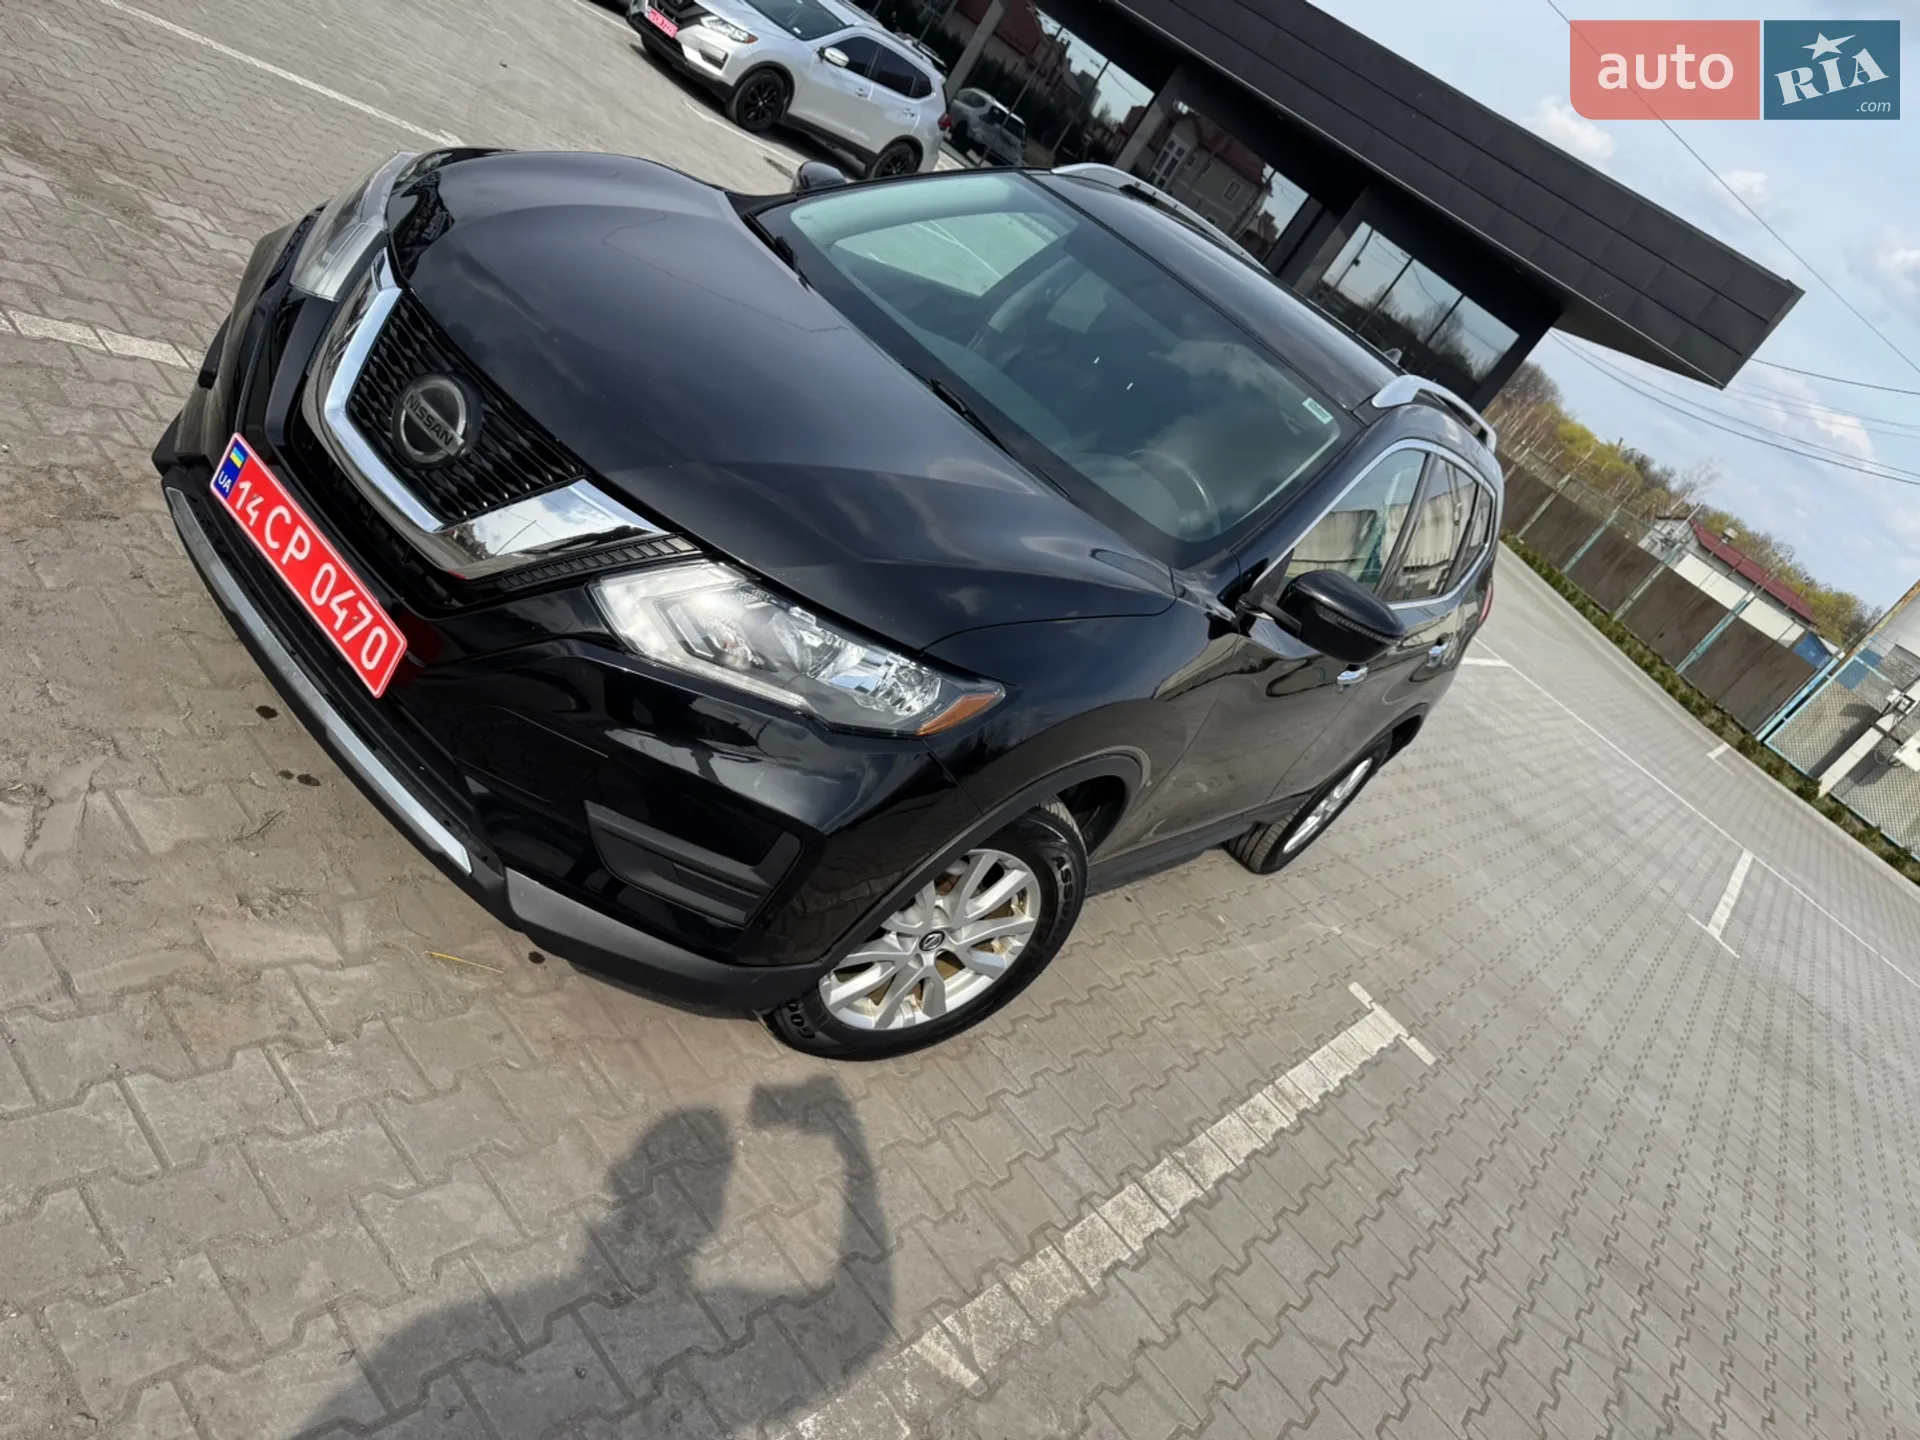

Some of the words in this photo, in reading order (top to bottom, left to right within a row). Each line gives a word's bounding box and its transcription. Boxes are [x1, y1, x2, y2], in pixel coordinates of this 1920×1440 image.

[406, 394, 455, 446] NISSAN
[218, 470, 232, 493] UA
[310, 562, 388, 671] 0470
